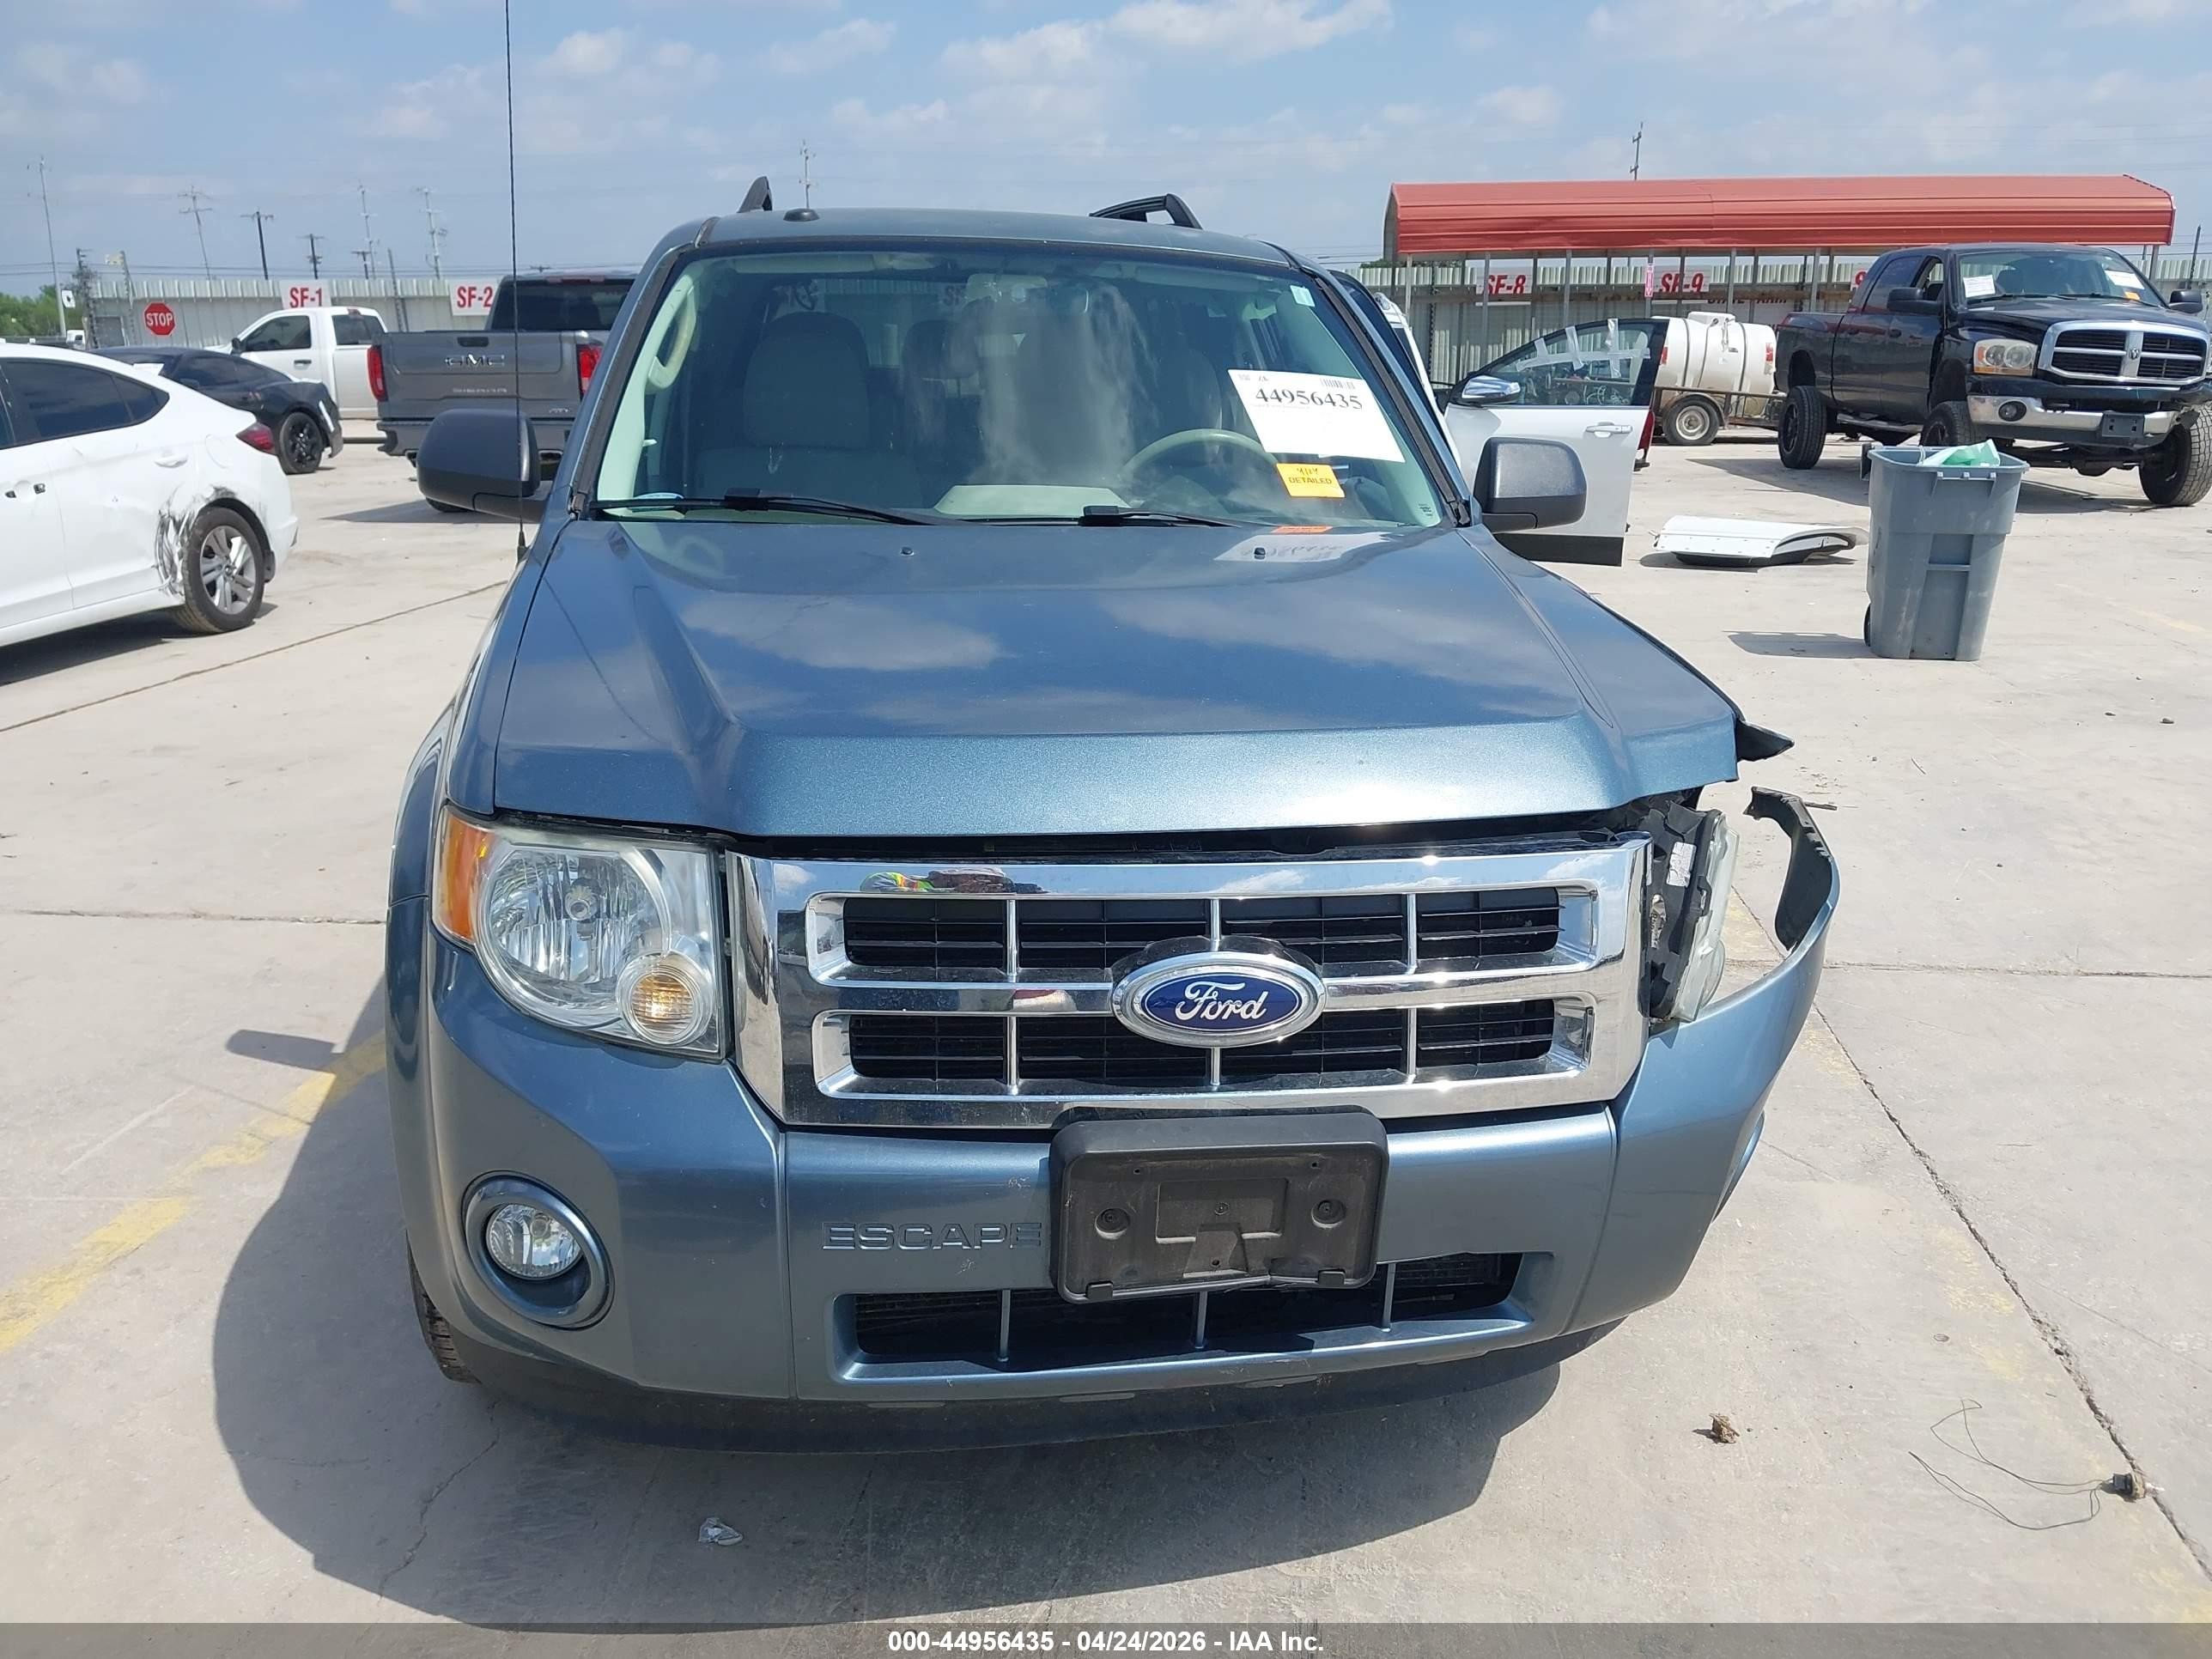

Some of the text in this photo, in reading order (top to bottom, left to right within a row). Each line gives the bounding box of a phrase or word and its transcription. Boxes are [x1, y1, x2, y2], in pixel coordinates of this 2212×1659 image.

[1483, 275, 1526, 295] SF-8
[1660, 273, 1705, 293] SF-9
[289, 287, 323, 308] SF-1
[457, 286, 493, 307] SF-2
[146, 312, 173, 327] STOP
[445, 354, 505, 366] GMC
[1255, 388, 1363, 410] 44956435
[1287, 477, 1332, 485] DETAILED
[1175, 981, 1268, 1020] Ford
[822, 1222, 1042, 1250] ESCAPE
